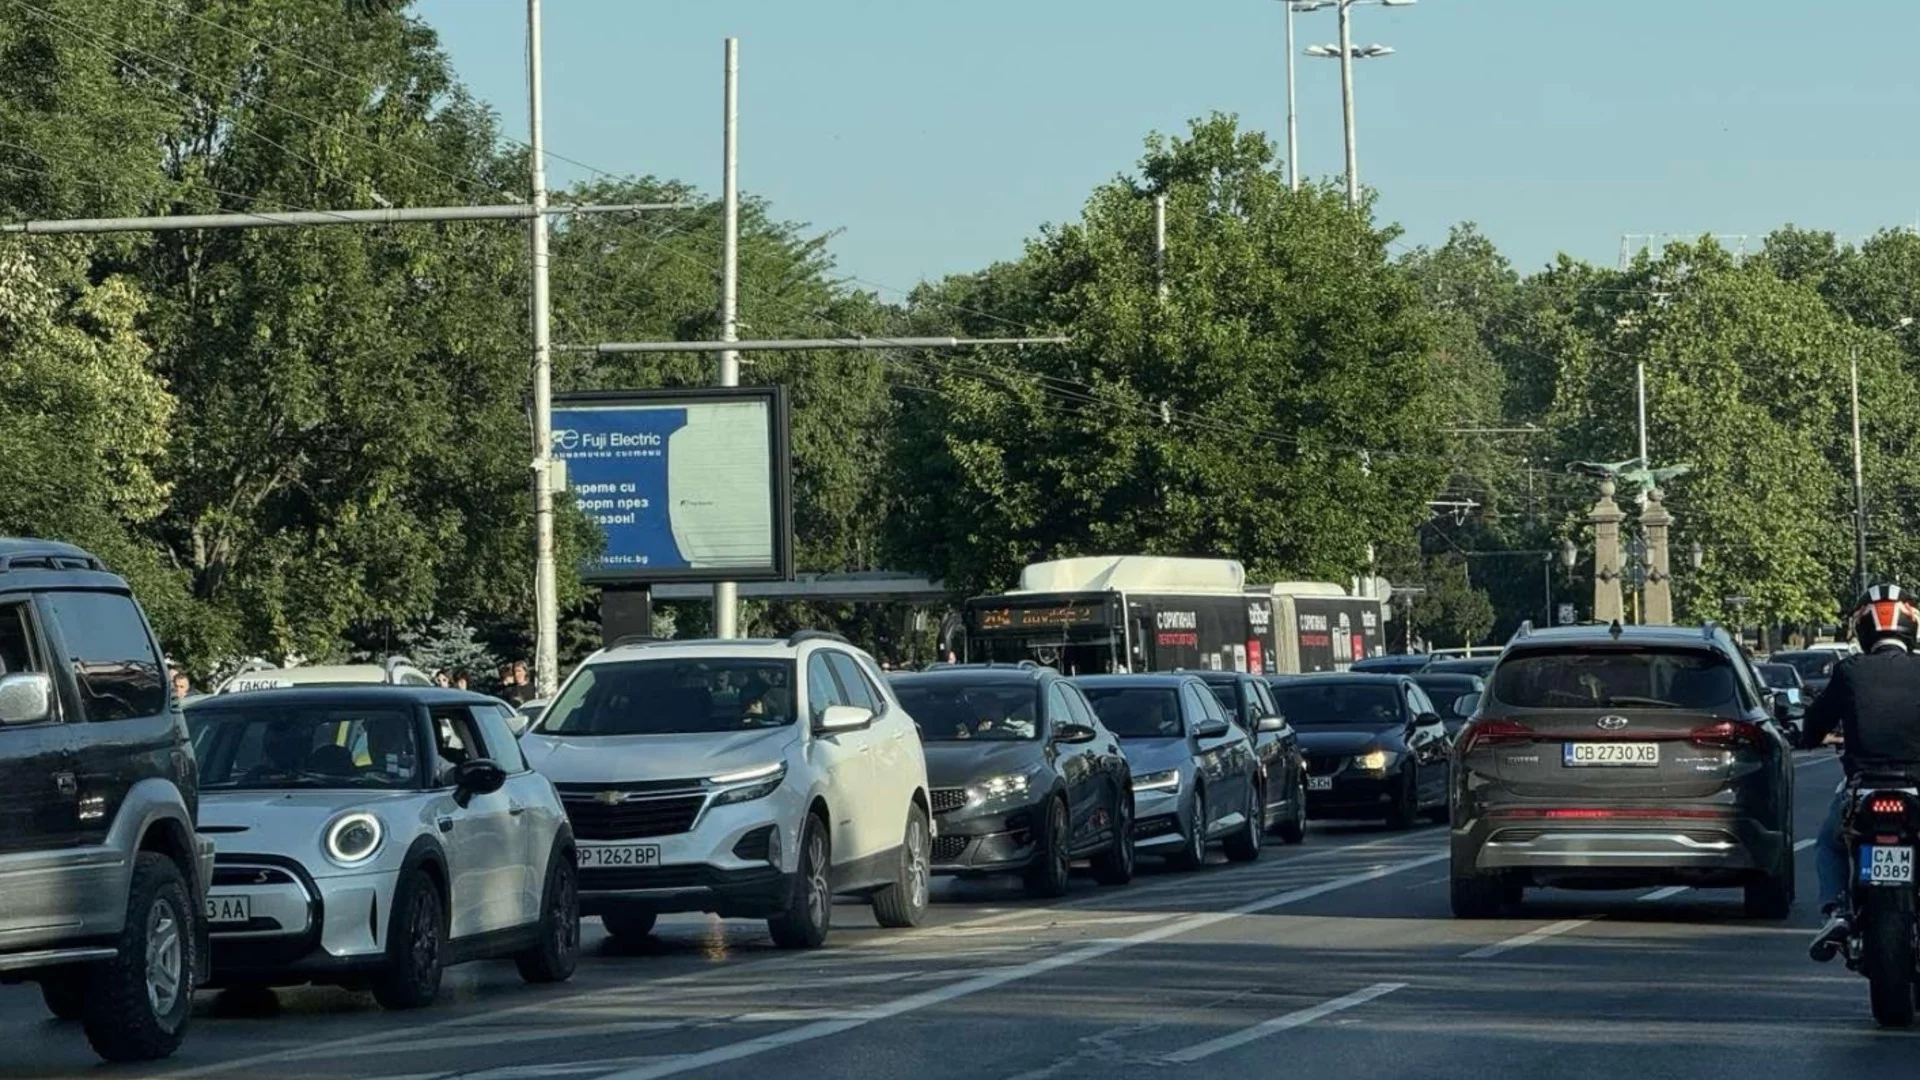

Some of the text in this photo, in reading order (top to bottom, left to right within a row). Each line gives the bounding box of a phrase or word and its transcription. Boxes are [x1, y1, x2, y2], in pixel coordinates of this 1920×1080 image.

[583, 432, 661, 449] Fuji Electric
[620, 483, 636, 492] си
[617, 498, 649, 510] през
[240, 680, 278, 692] ТАКСИ
[1575, 746, 1655, 760] CB 2730 XB
[596, 848, 632, 864] 1262
[635, 848, 656, 864] BP
[1874, 850, 1910, 864] CA M
[1873, 864, 1910, 878] 0389
[221, 899, 245, 919] AA
